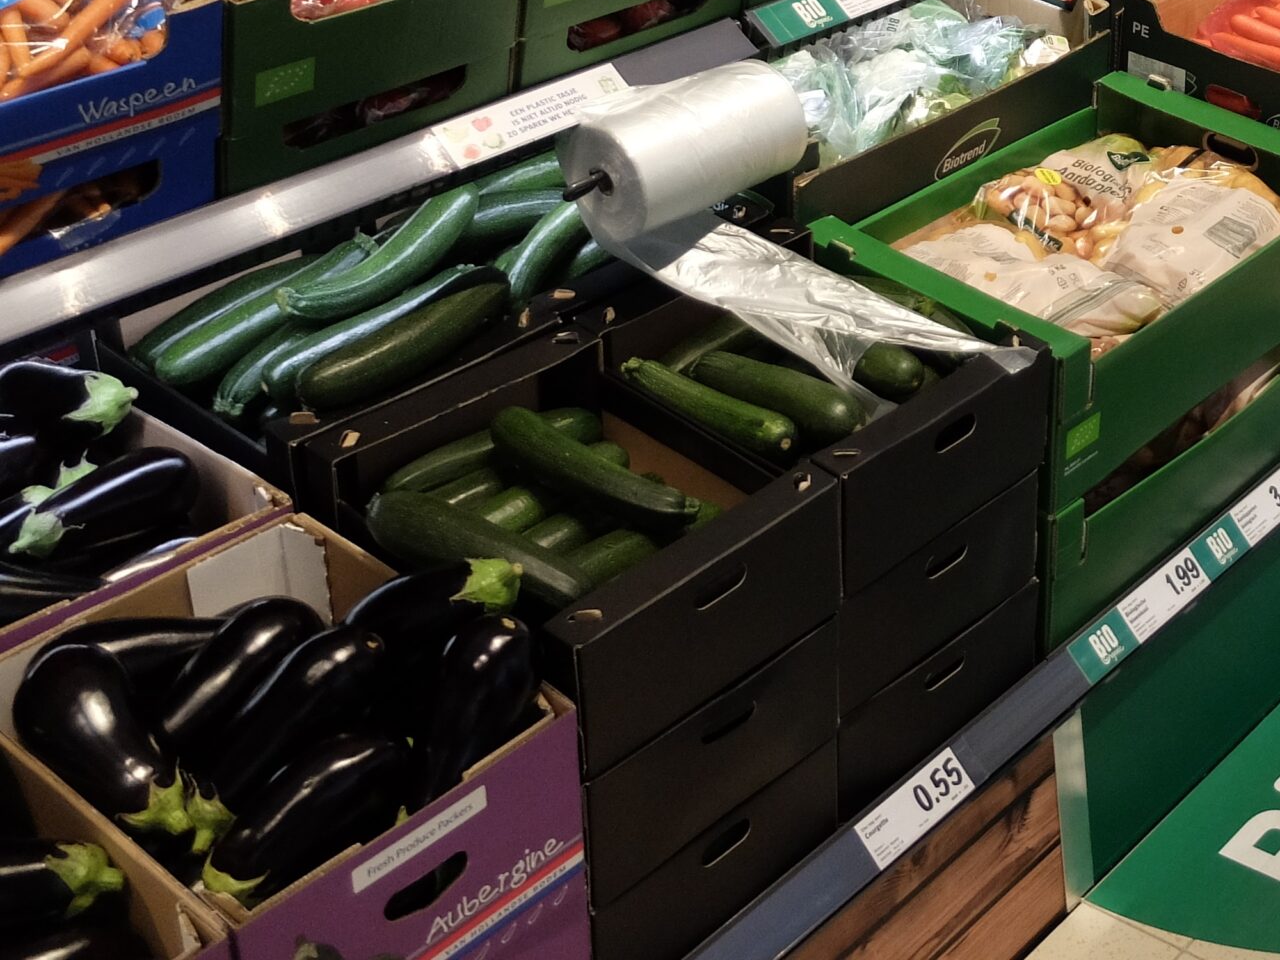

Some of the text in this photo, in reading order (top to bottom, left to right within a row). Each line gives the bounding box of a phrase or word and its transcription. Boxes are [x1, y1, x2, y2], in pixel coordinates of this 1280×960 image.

[77, 77, 197, 125] Waspeen
[942, 139, 987, 173] Biotrend
[1165, 557, 1201, 596] 1.99
[913, 757, 963, 812] 0.55
[367, 803, 475, 878] Fresh Produce Packers
[426, 837, 565, 945] Aubergine
